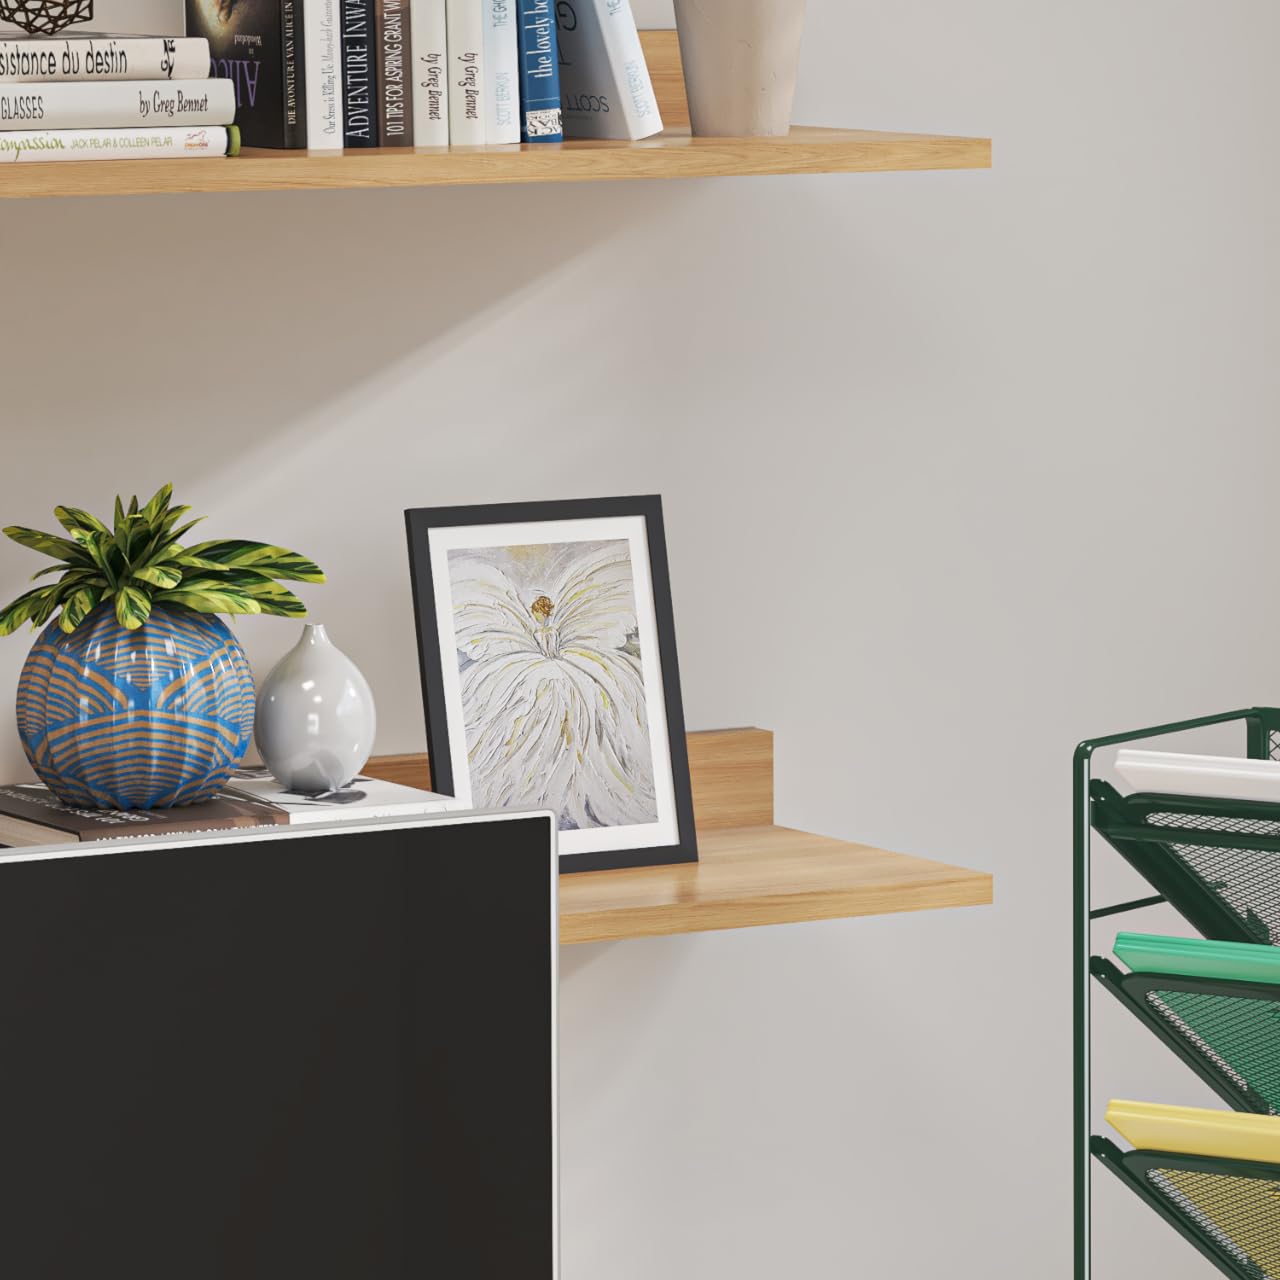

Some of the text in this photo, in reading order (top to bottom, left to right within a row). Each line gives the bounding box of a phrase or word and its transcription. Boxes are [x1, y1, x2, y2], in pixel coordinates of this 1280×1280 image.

[524, 17, 554, 55] lovely
[62, 40, 80, 75] du
[85, 39, 128, 74] destin
[284, 1, 297, 125] DIE AVONTURE VAN ALICE IN
[527, 56, 553, 78] the
[321, 75, 336, 96] Killing
[383, 13, 405, 137] 101 TIPS FOR ASPIRING GRANT
[420, 53, 443, 120] by Greg Bennet
[457, 52, 480, 119] by Greg Bennet
[138, 90, 209, 118] by Greg Bennet
[345, 44, 370, 139] ADVENTURE
[566, 93, 610, 113] SCOTT
[0, 95, 44, 120] GLASSES
[322, 102, 336, 123] Stress
[70, 138, 89, 150] JACK
[119, 136, 149, 149] COLLEEN
[150, 136, 173, 148] PELAR
[322, 123, 336, 135] Our
